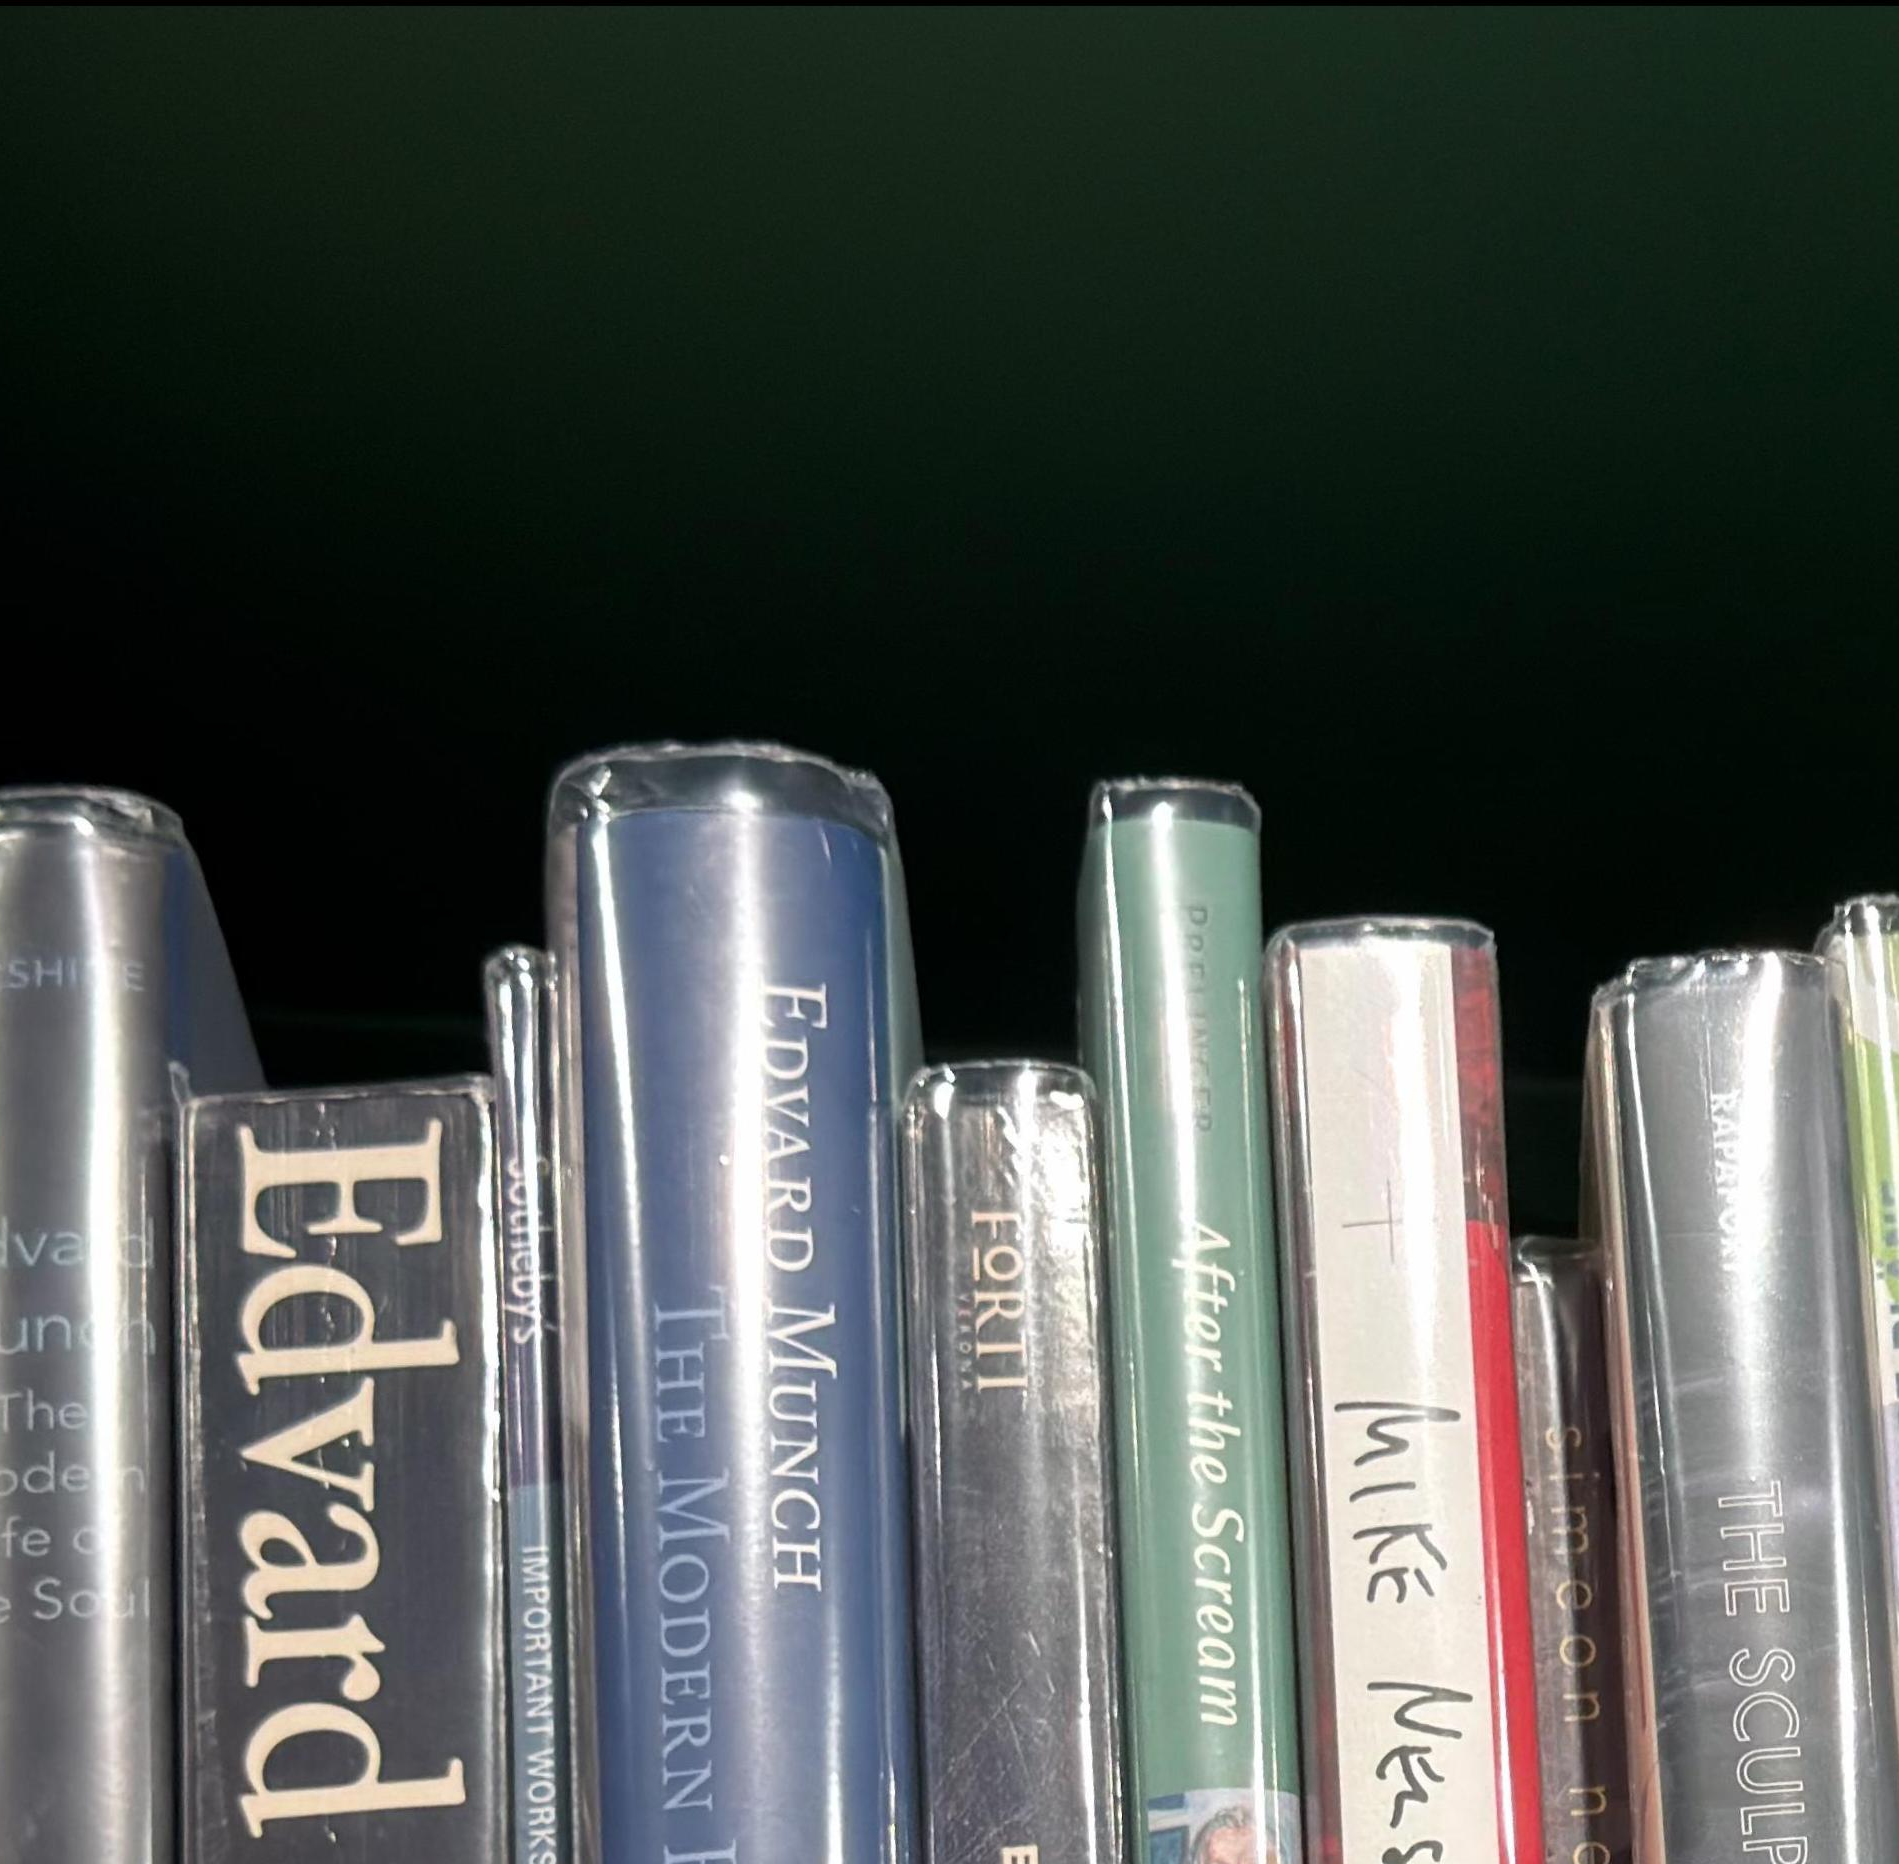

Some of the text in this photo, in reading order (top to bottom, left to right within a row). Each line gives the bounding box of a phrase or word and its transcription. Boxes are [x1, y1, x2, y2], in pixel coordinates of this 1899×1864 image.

[972, 1211, 1028, 1393] FORTI
[239, 1117, 466, 1838] Edvard
[763, 1302, 838, 1594] MUNCH
[1171, 1220, 1241, 1727] After the Scream
[1334, 1401, 1460, 1607] MIKE
[1717, 1479, 1791, 1617] THE
[34, 1577, 150, 1620] Soul
[522, 1546, 554, 1736] IMPORTANT
[1544, 1425, 1602, 1724] simeon
